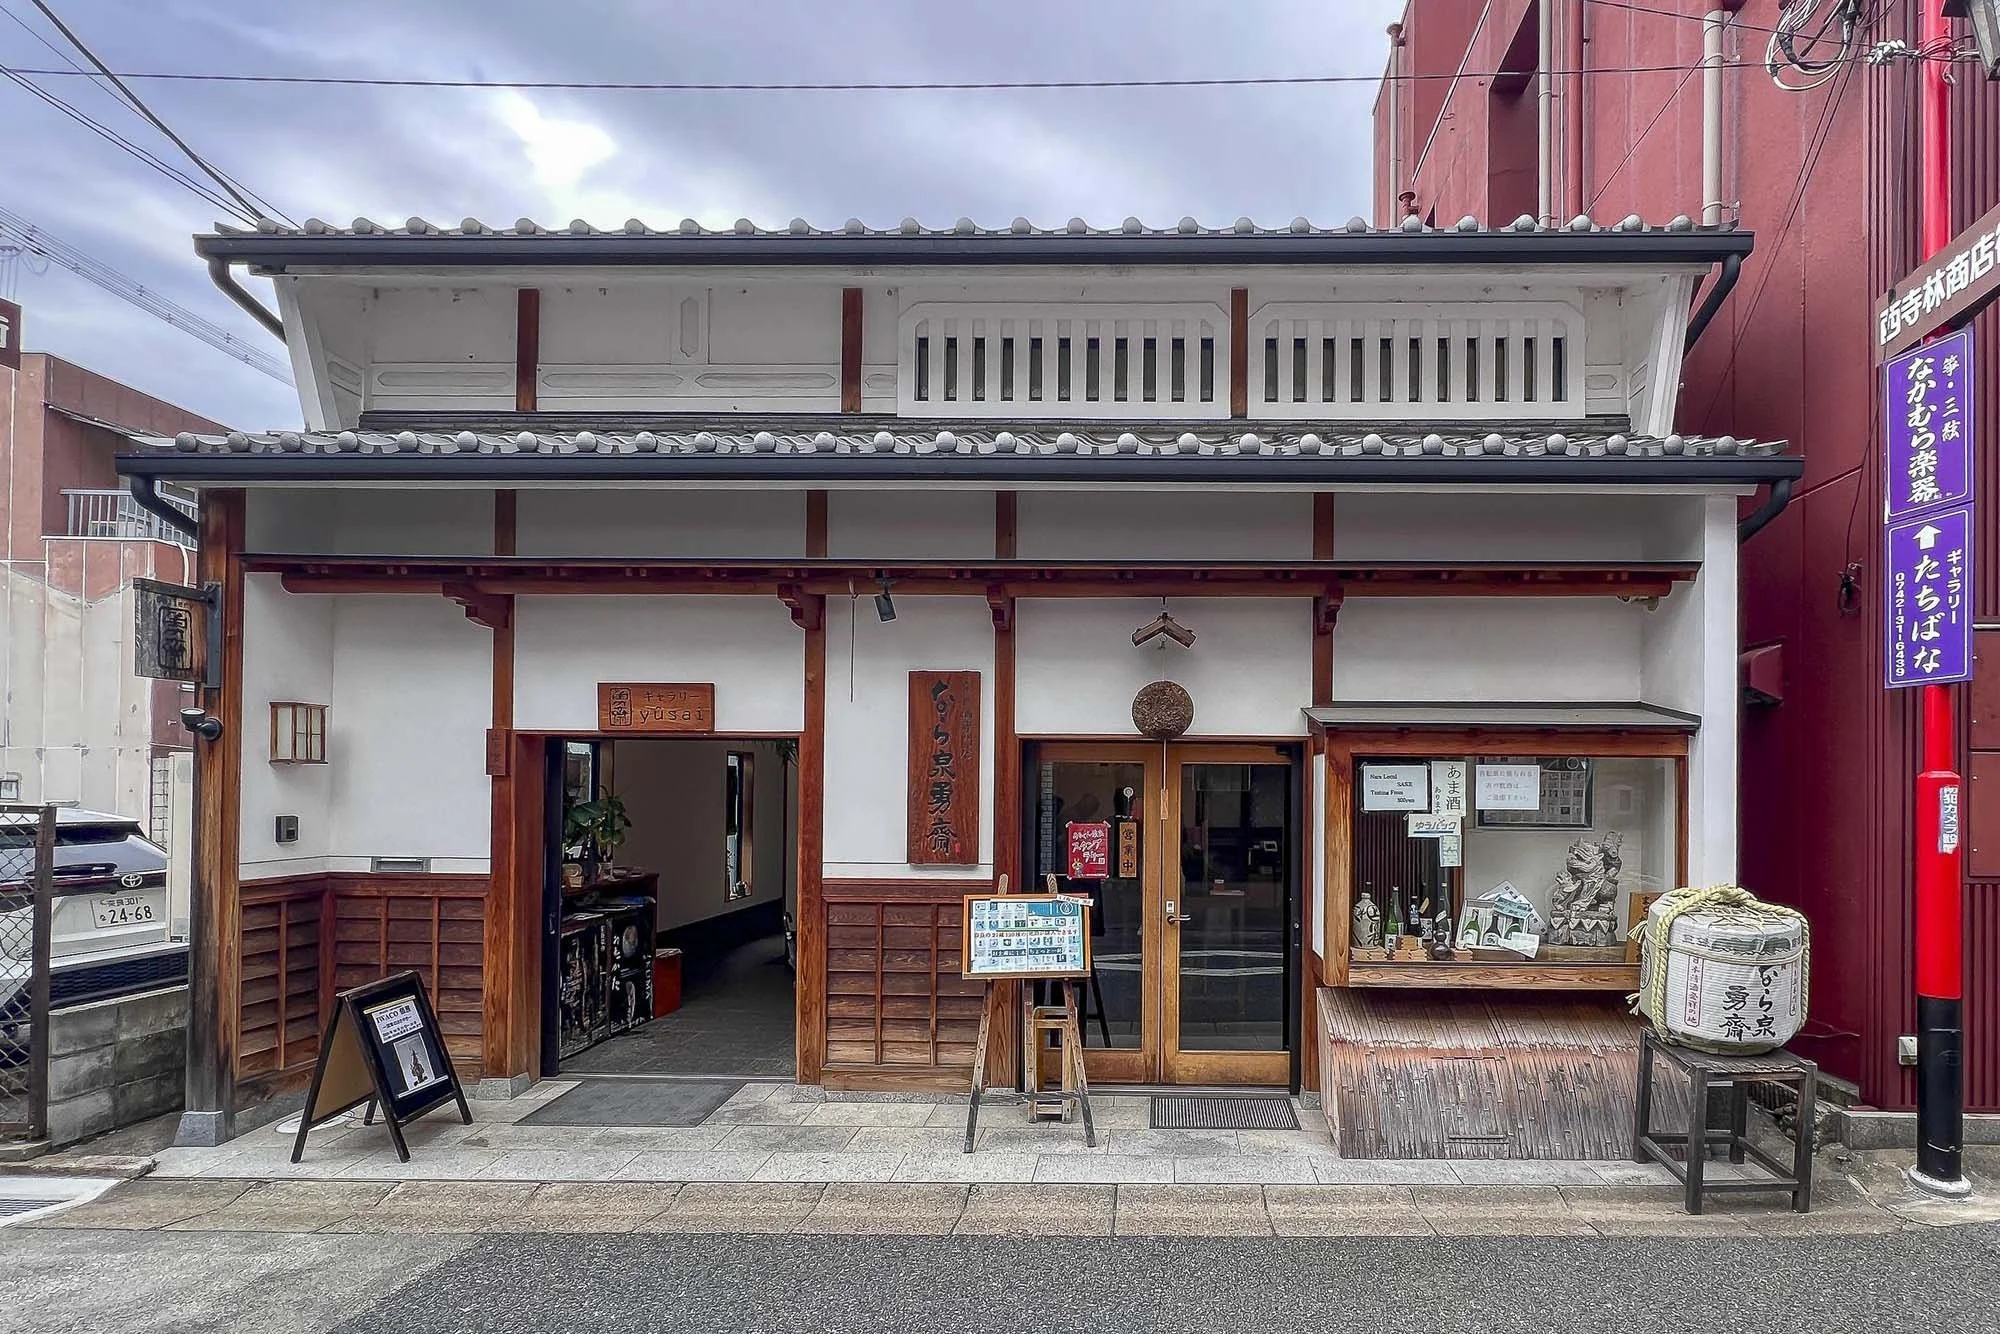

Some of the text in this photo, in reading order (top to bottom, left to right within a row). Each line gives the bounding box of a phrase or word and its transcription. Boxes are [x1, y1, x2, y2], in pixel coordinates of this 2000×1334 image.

[1880, 222, 2000, 346] 西寺林商店
[1906, 356, 1940, 504] なかむら楽器
[1946, 548, 1963, 624] ギャラリー
[1911, 554, 1946, 674] たちばな
[1434, 786, 1442, 815] あります
[1446, 765, 1461, 810] あま酒
[1415, 818, 1457, 830] ゆうパック
[1122, 828, 1134, 871] 営業中
[108, 905, 152, 924] 24-68
[375, 1010, 399, 1024] IWACO
